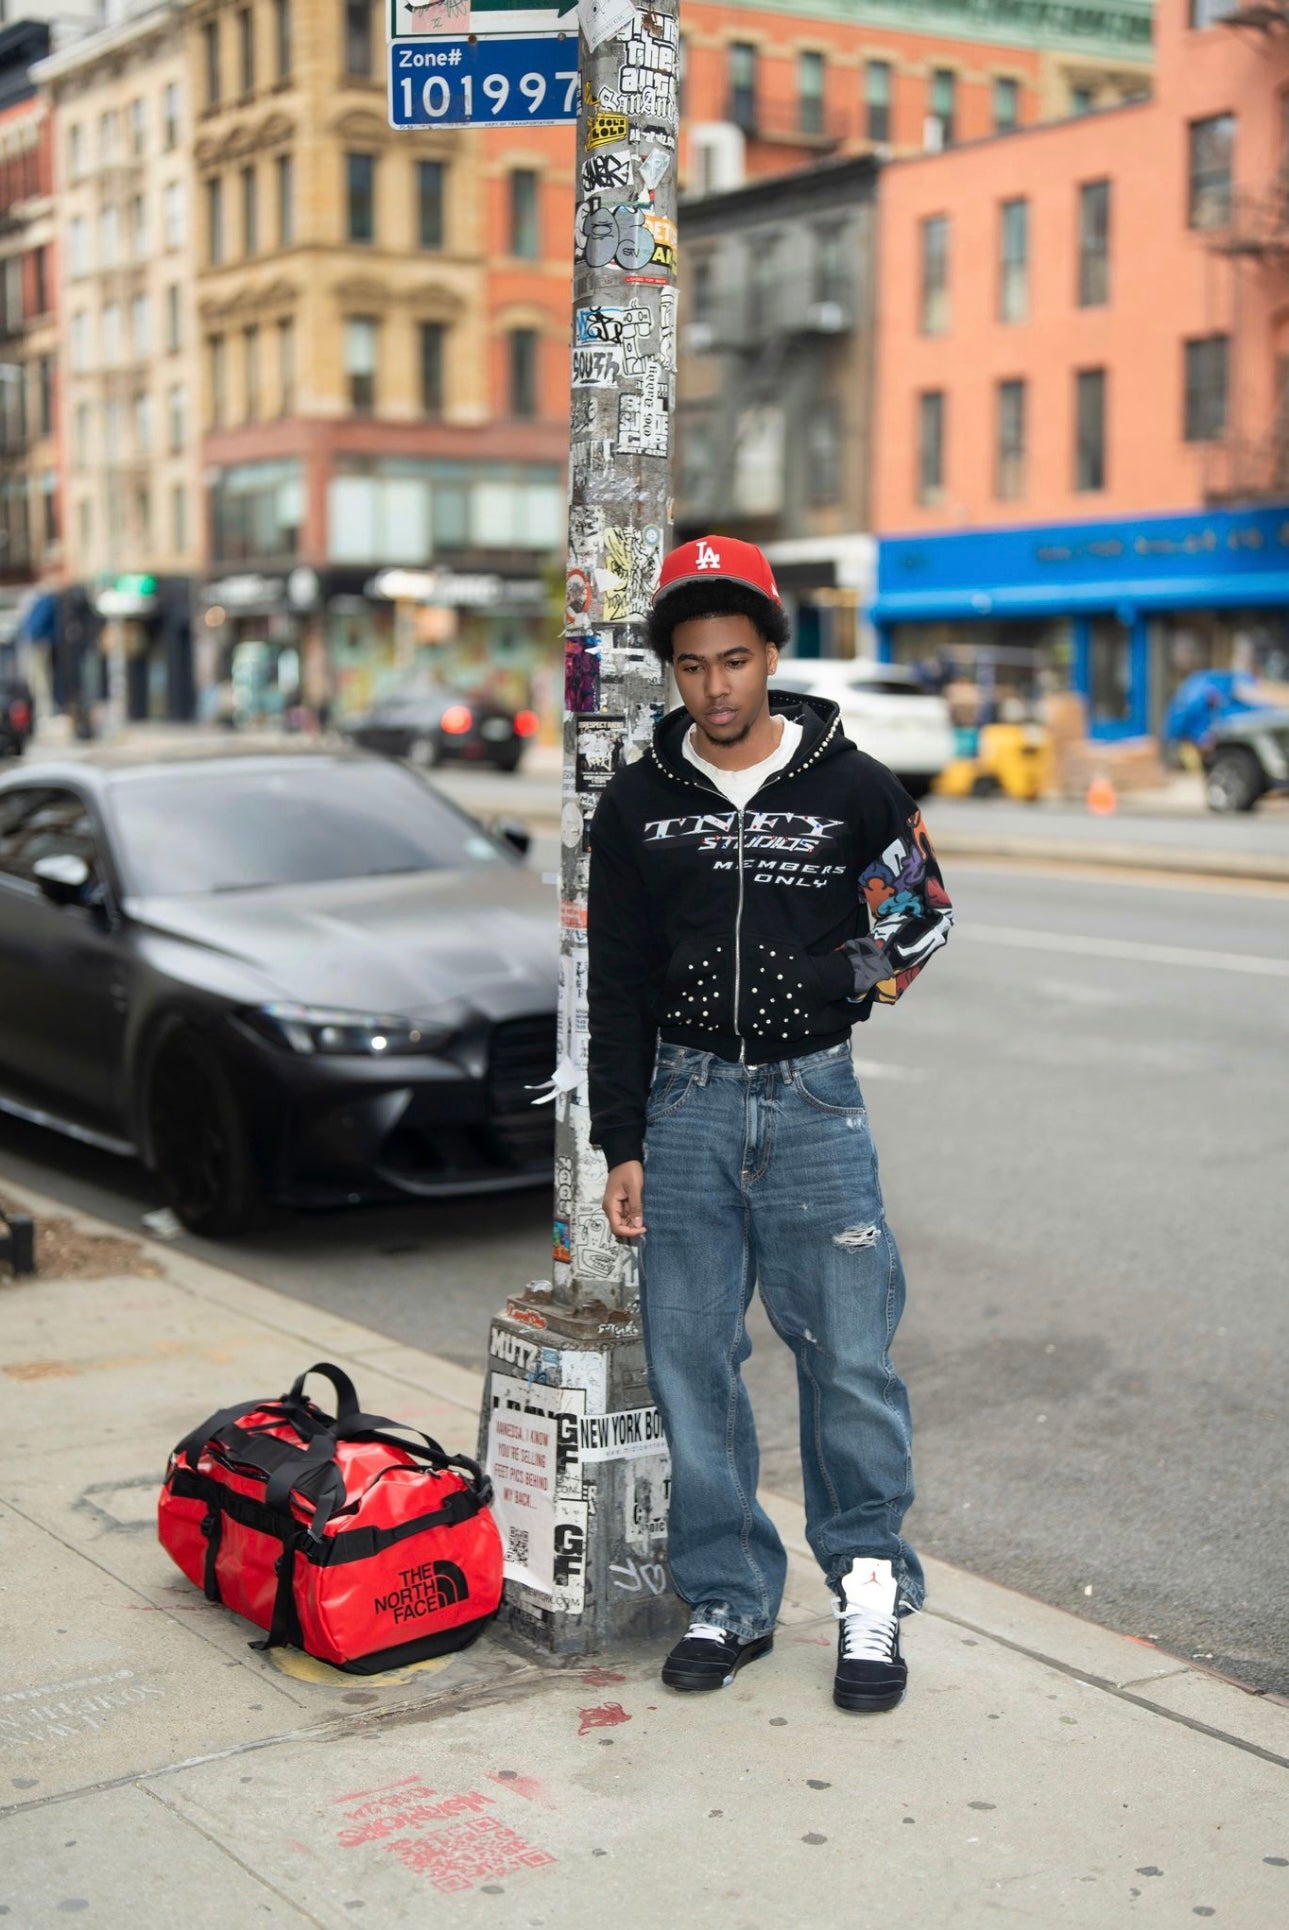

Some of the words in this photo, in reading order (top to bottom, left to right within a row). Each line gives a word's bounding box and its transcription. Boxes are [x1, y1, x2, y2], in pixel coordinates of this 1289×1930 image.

[399, 49, 463, 68] Zone#
[400, 71, 578, 118] 101997
[695, 541, 720, 570] LA
[698, 835, 820, 852] STUDIOS
[713, 859, 846, 874] MEMBERS
[754, 873, 828, 888] ONLY
[531, 1430, 549, 1447] KNOW
[580, 1418, 609, 1449] NEW
[611, 1412, 642, 1446] YORK
[498, 1443, 519, 1461] YOU'RE
[520, 1448, 546, 1468] SELLING
[494, 1462, 509, 1479] FEET
[510, 1467, 524, 1484] PICS
[525, 1472, 548, 1491] BEHIND
[503, 1486, 513, 1500] MY
[398, 1562, 433, 1587] THE
[374, 1579, 436, 1615] NORTH
[393, 1595, 438, 1624] FACE
